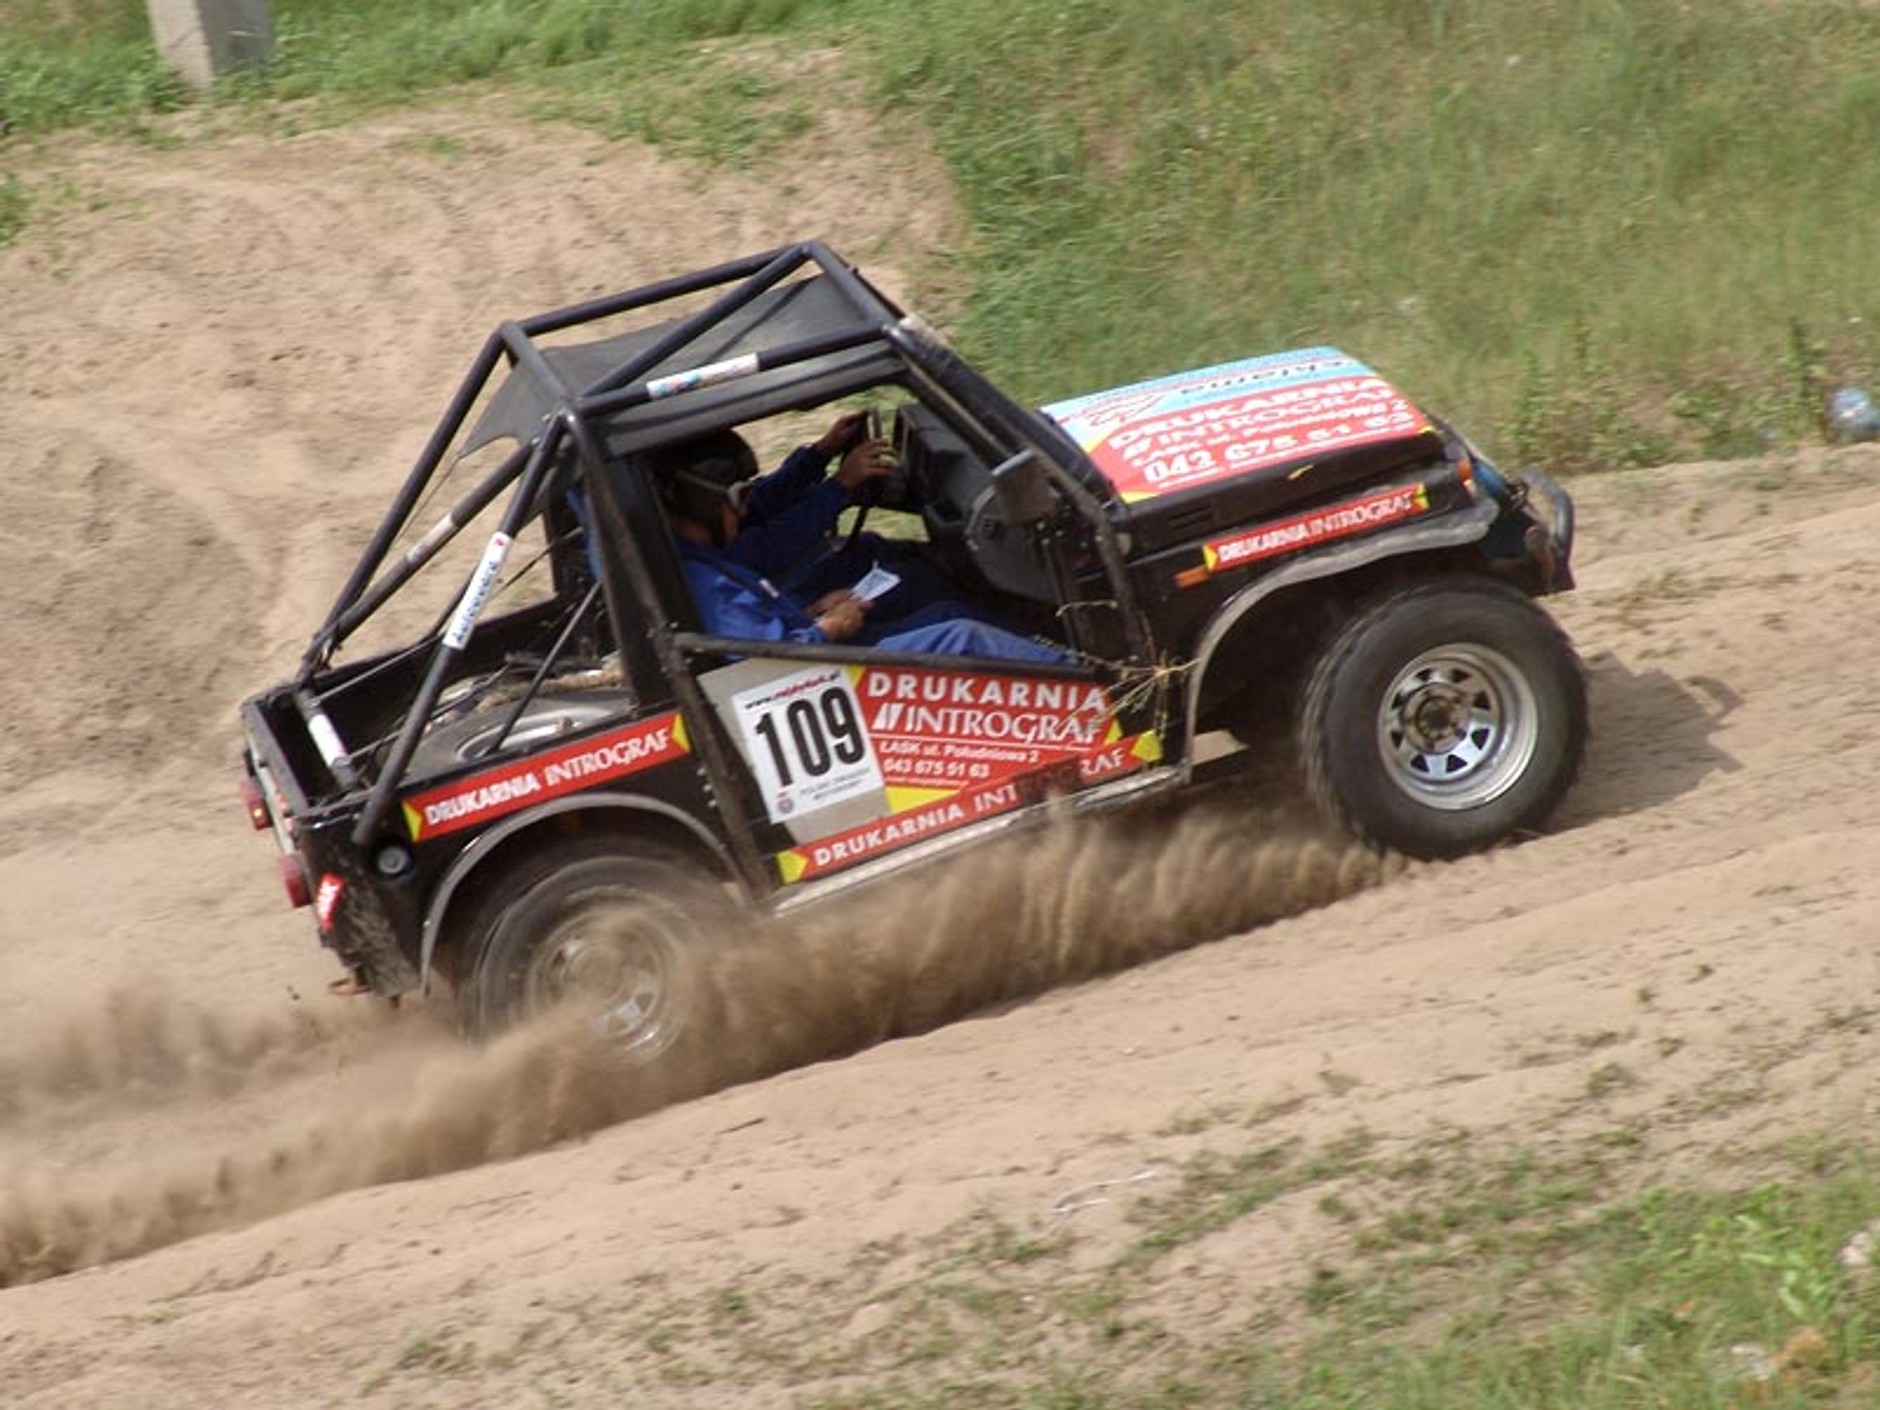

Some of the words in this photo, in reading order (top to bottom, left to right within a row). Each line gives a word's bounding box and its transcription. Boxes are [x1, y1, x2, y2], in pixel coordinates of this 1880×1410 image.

[1109, 378, 1389, 449] DRUKARNIA
[1143, 450, 1217, 483] 043
[1224, 434, 1298, 464] 675
[1218, 523, 1310, 563] DRUKARNIA
[868, 671, 1107, 713] DRUKARNIA
[755, 686, 866, 788] 109
[904, 705, 1102, 745] INTROGRAF
[424, 771, 541, 826] DRUKARNIA
[545, 727, 669, 786] INTROGRAF
[914, 759, 944, 776] 675
[968, 763, 991, 779] 63
[1029, 750, 1039, 763] 2
[813, 802, 965, 867] DRUKARNIA
